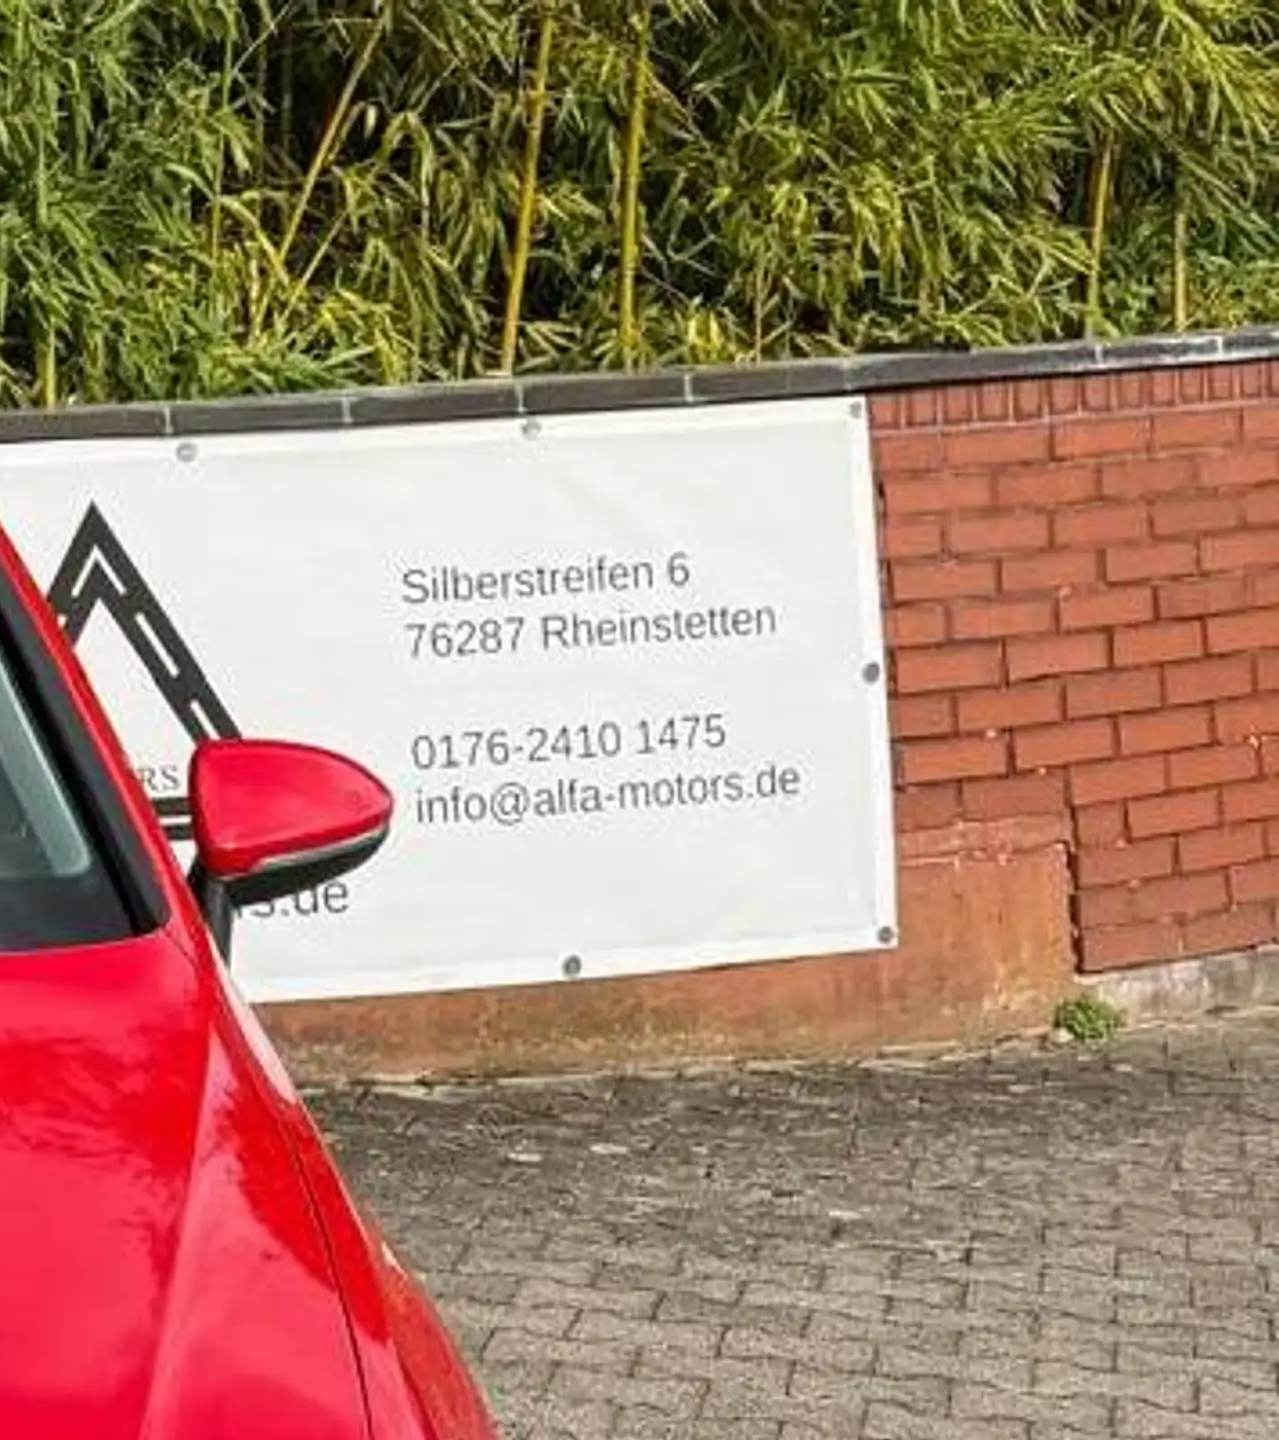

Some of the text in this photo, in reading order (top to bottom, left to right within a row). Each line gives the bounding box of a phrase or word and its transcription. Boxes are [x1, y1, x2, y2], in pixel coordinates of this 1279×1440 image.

[402, 551, 691, 604] Silberstreifen 6
[405, 606, 777, 658] 76287 Rheinstetten
[410, 712, 726, 770] 0176-2410 1475
[416, 765, 802, 826] info@alfa-motors.de
